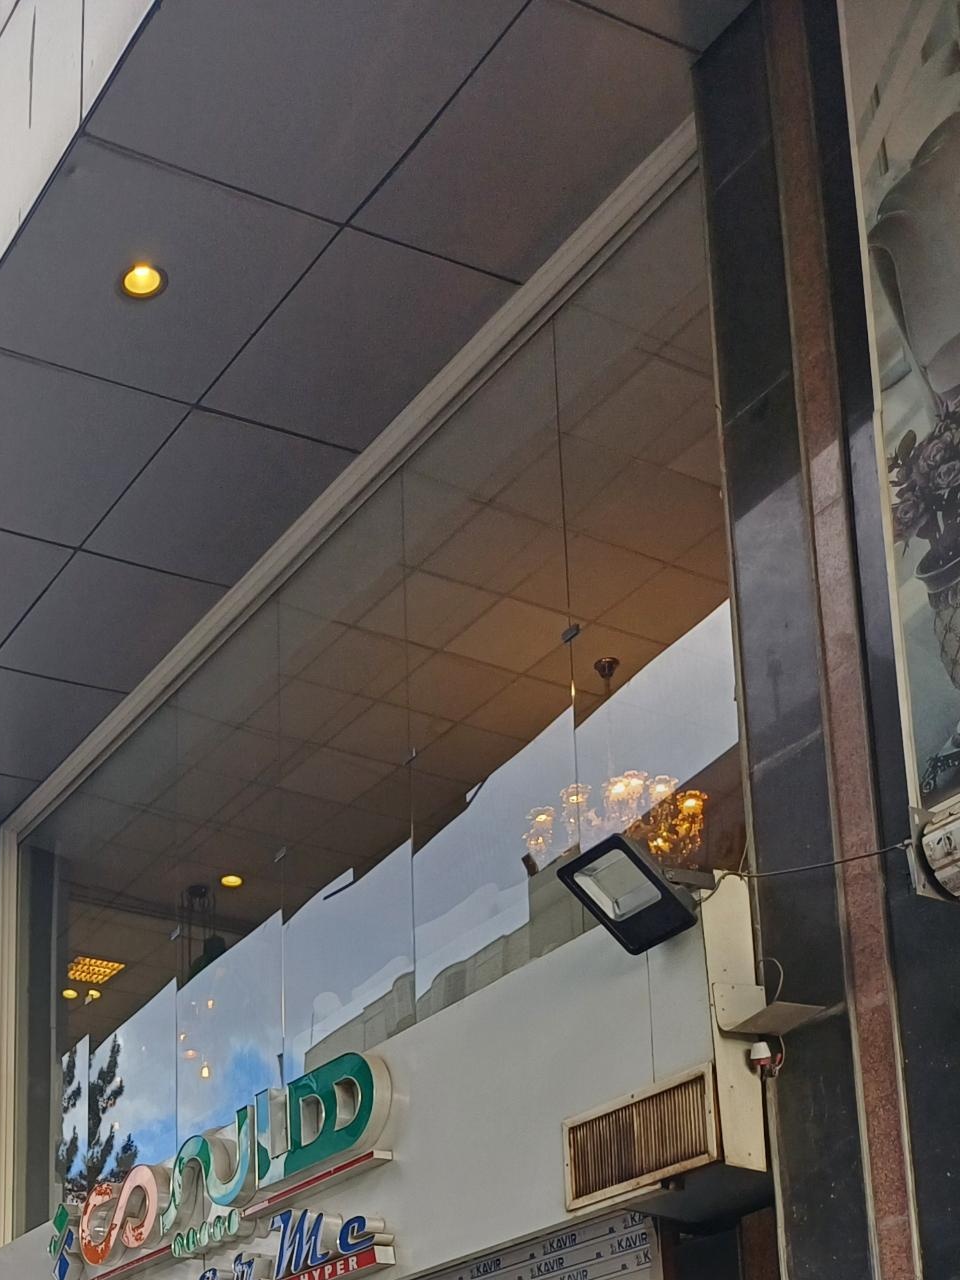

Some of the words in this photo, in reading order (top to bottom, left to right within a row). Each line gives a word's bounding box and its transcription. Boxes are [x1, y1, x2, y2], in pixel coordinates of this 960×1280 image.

[476, 1258, 502, 1276] KAVIR
[548, 1233, 577, 1250] KAVIR
[536, 1256, 565, 1275] KAVIR
[617, 1232, 648, 1250] KAVIR
